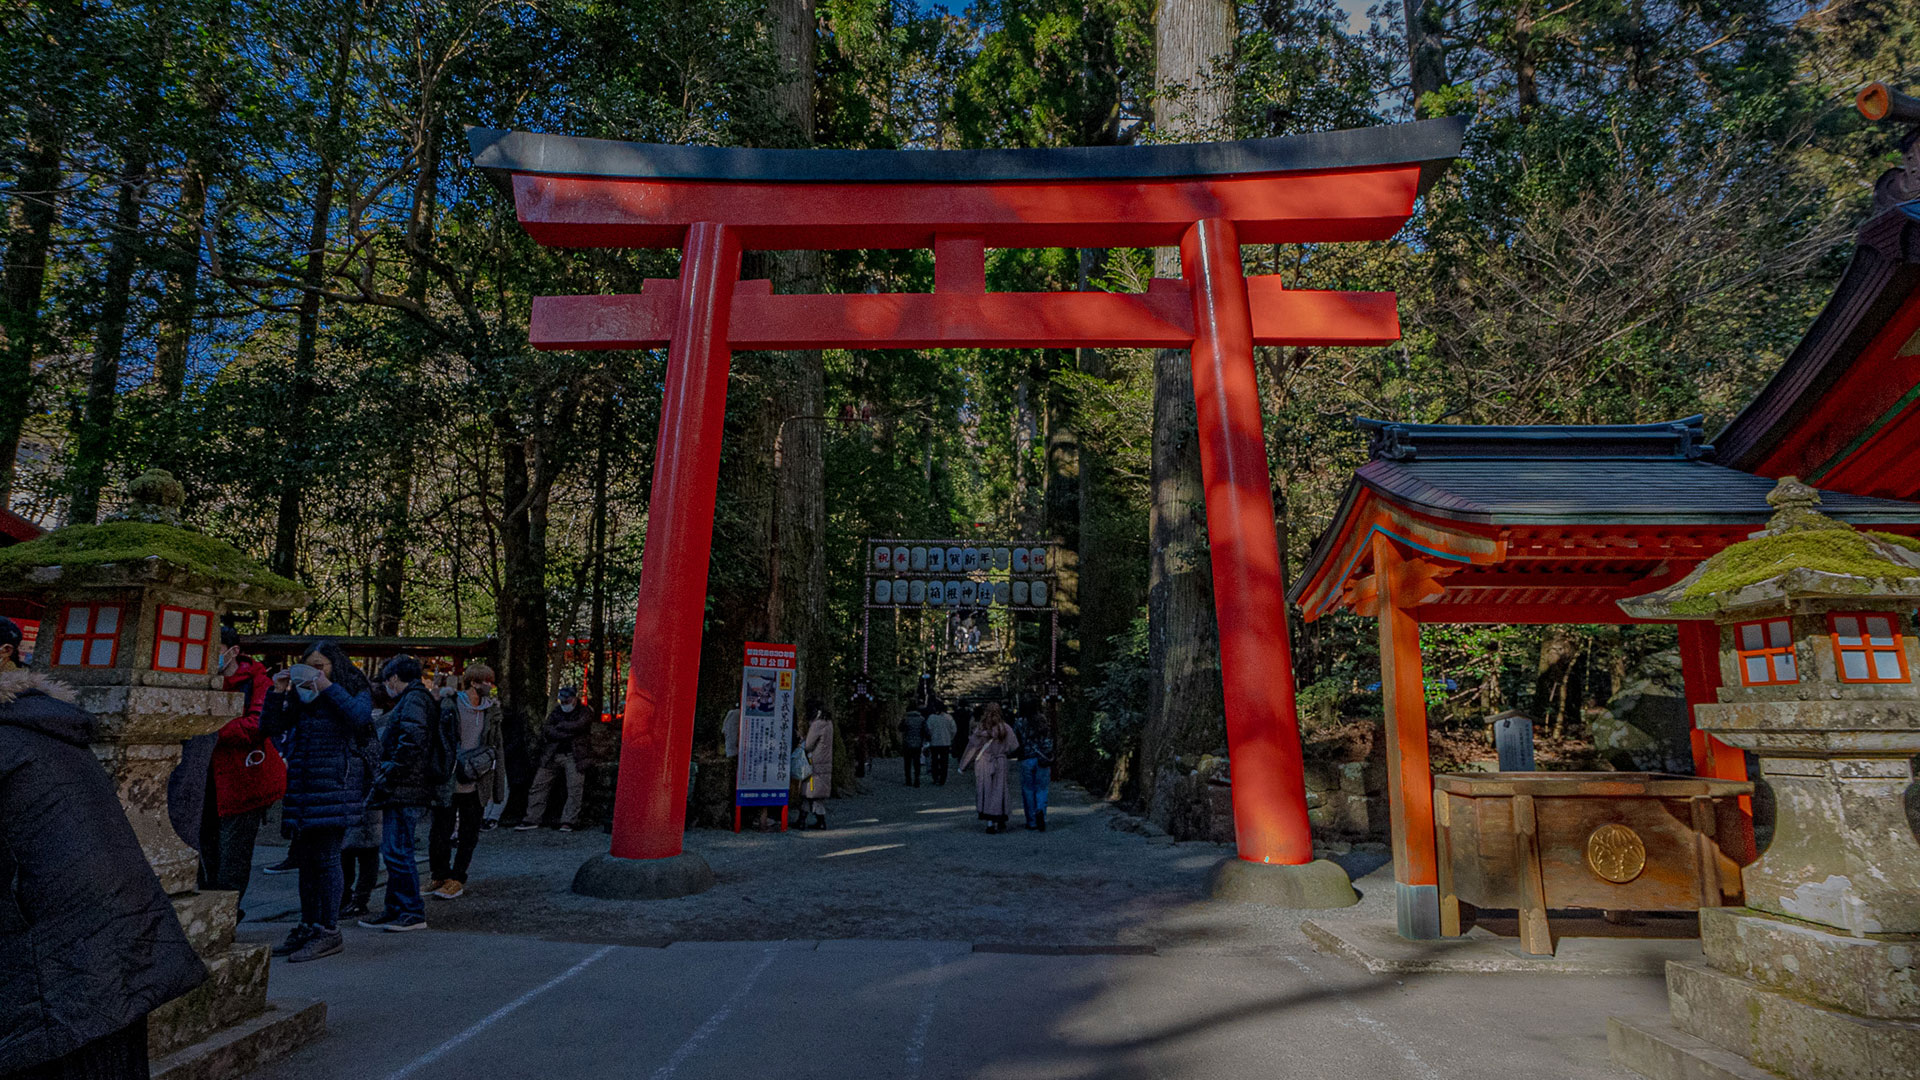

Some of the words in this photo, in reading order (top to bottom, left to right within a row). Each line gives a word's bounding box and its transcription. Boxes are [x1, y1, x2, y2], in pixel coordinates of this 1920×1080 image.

[929, 552, 990, 566] 謹賀新年
[930, 586, 991, 600] 箱根神社
